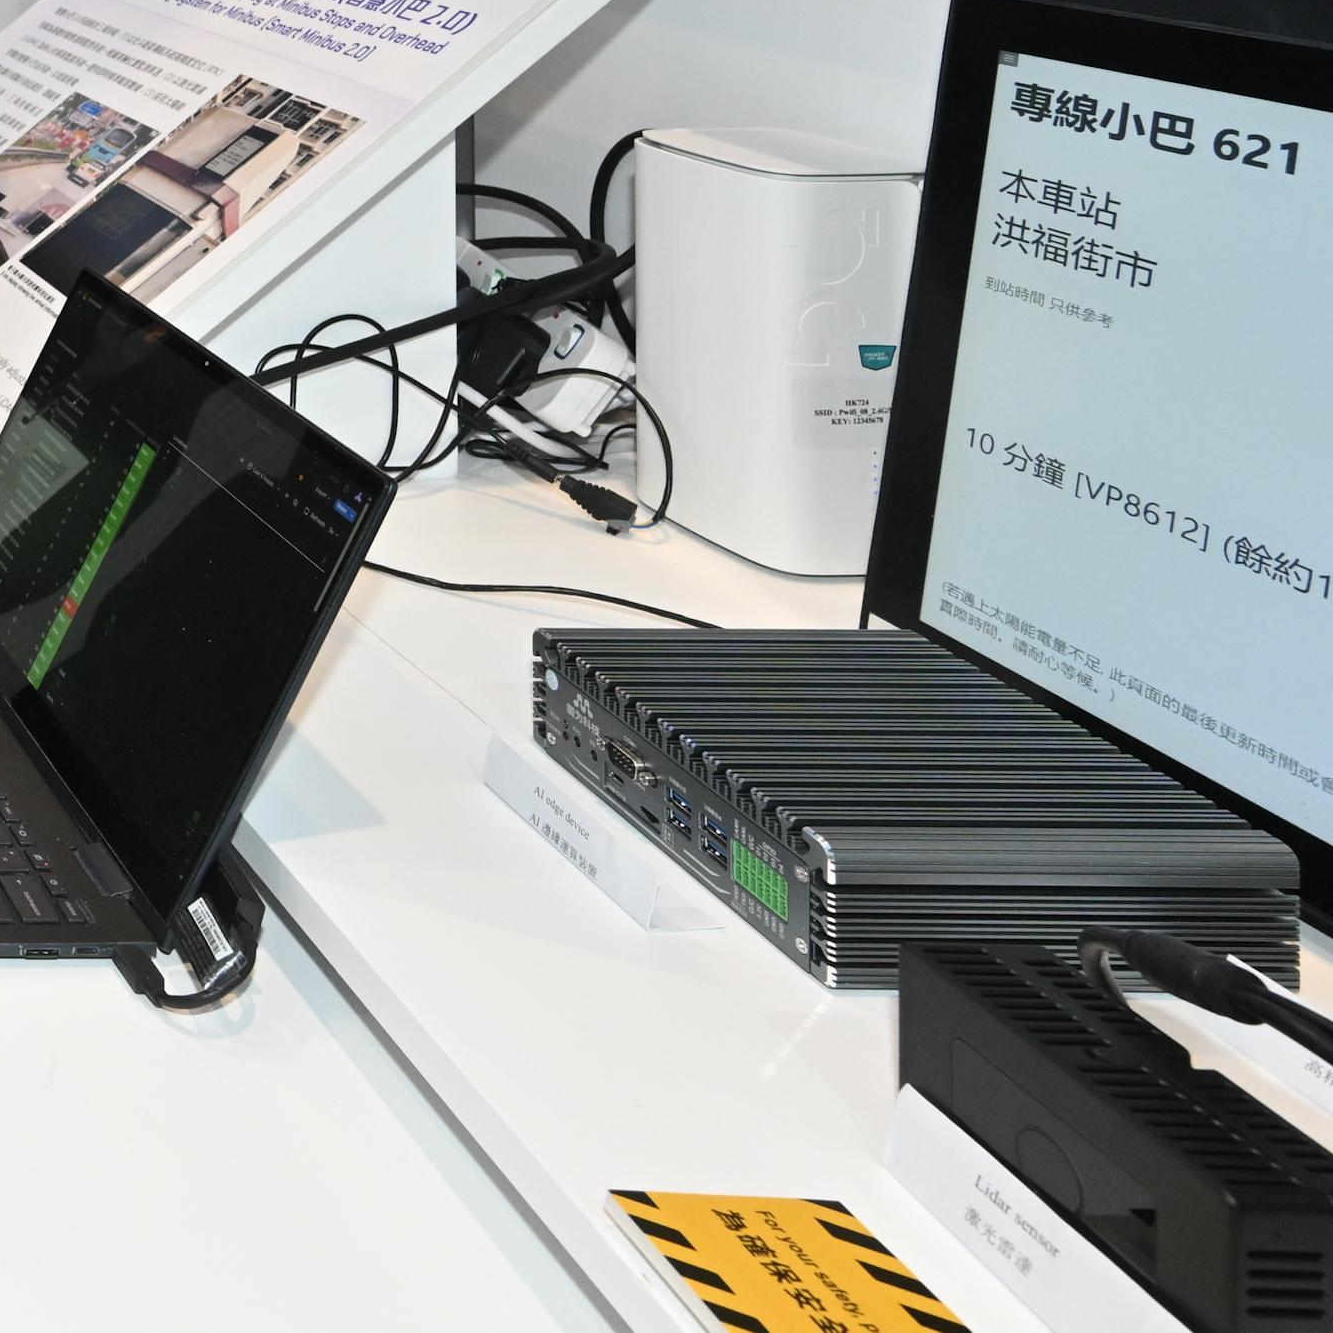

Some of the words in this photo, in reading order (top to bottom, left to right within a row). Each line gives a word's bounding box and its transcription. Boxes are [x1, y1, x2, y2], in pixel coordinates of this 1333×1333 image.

[211, 0, 228, 16] for
[227, 3, 264, 30] Minibus
[262, 14, 299, 46] (Smart
[298, 24, 345, 57] Minibus
[345, 39, 377, 63] 2.0)
[319, 6, 354, 32] Stops
[353, 17, 379, 37] and
[380, 24, 451, 57] Overhead
[422, 5, 480, 35] 2.0)
[1011, 81, 1196, 156] 專線小巴
[1212, 128, 1299, 176] 621
[999, 169, 1121, 231] 本車站
[991, 212, 1158, 289] 洪福街市
[984, 275, 1045, 308] 到站時間
[1048, 297, 1114, 329] 只供參考
[966, 428, 994, 456] 10
[1003, 441, 1066, 490] 分鐘
[1075, 471, 1210, 553] [VP8612]
[529, 813, 542, 828] AI
[533, 786, 545, 800] AI
[545, 792, 565, 818] edge
[565, 810, 590, 840] device
[754, 1209, 781, 1237] For
[776, 1231, 817, 1273] your
[963, 1203, 1035, 1279] 激光雷達
[973, 1172, 1014, 1215] Lidar
[1014, 1218, 1062, 1260] sensor
